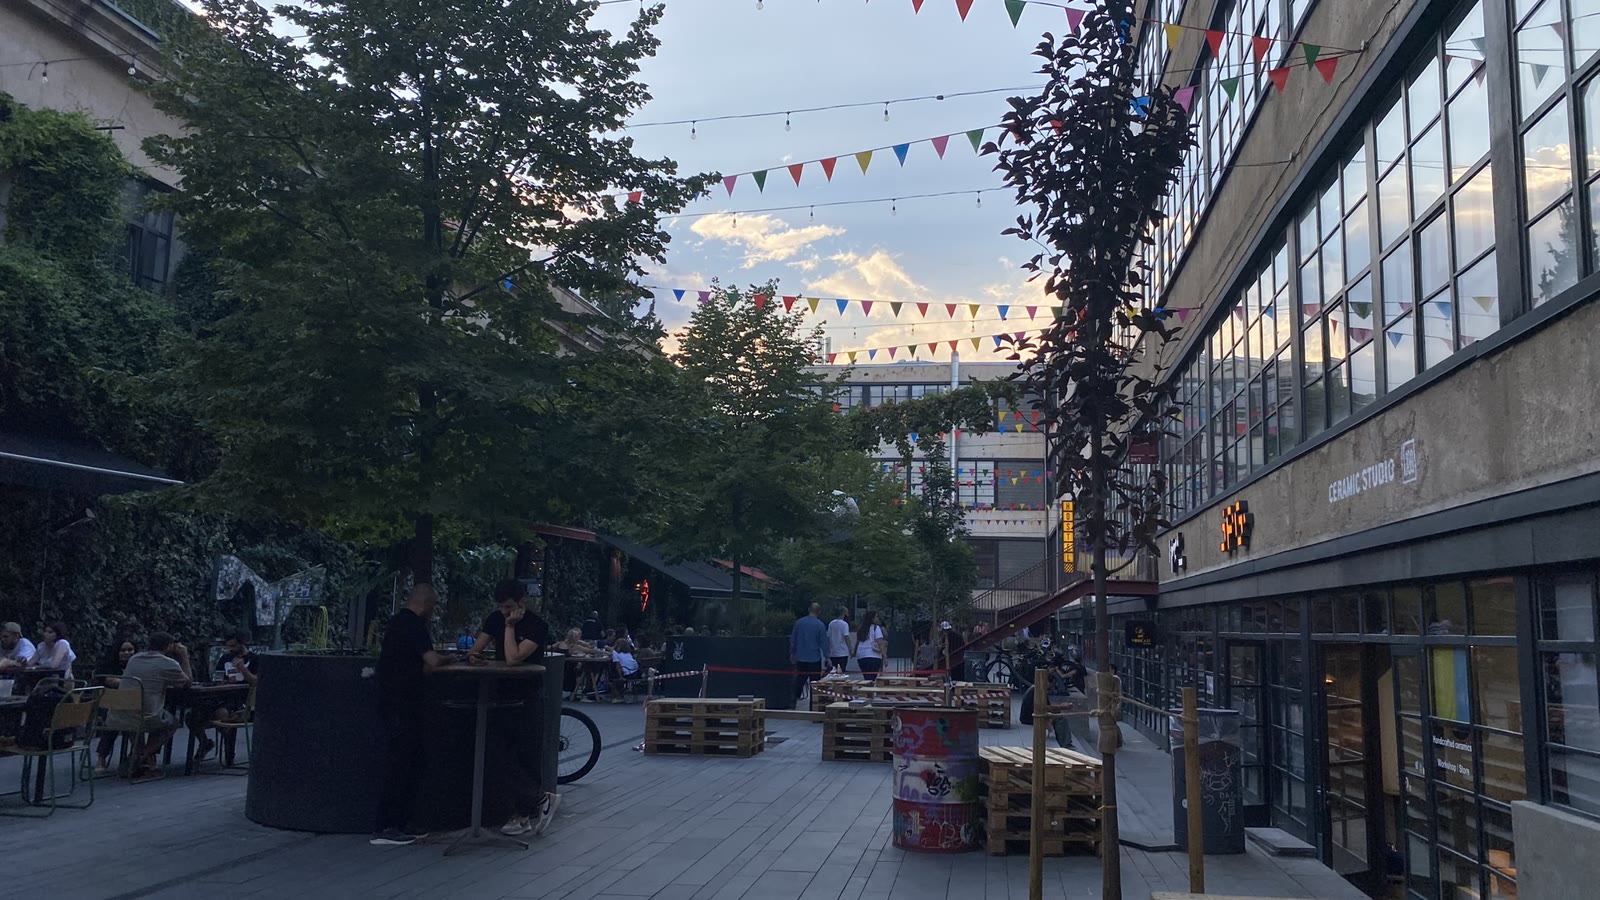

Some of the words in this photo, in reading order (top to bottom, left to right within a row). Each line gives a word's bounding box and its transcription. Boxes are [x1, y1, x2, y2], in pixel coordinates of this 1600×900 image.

[1329, 472, 1360, 503] CERAMIC
[1362, 459, 1394, 490] STUDIO
[1063, 502, 1073, 562] HOSTEL
[1432, 735, 1455, 748] Handcrafted
[1455, 742, 1472, 752] ceramics
[1437, 758, 1456, 772] Workshop
